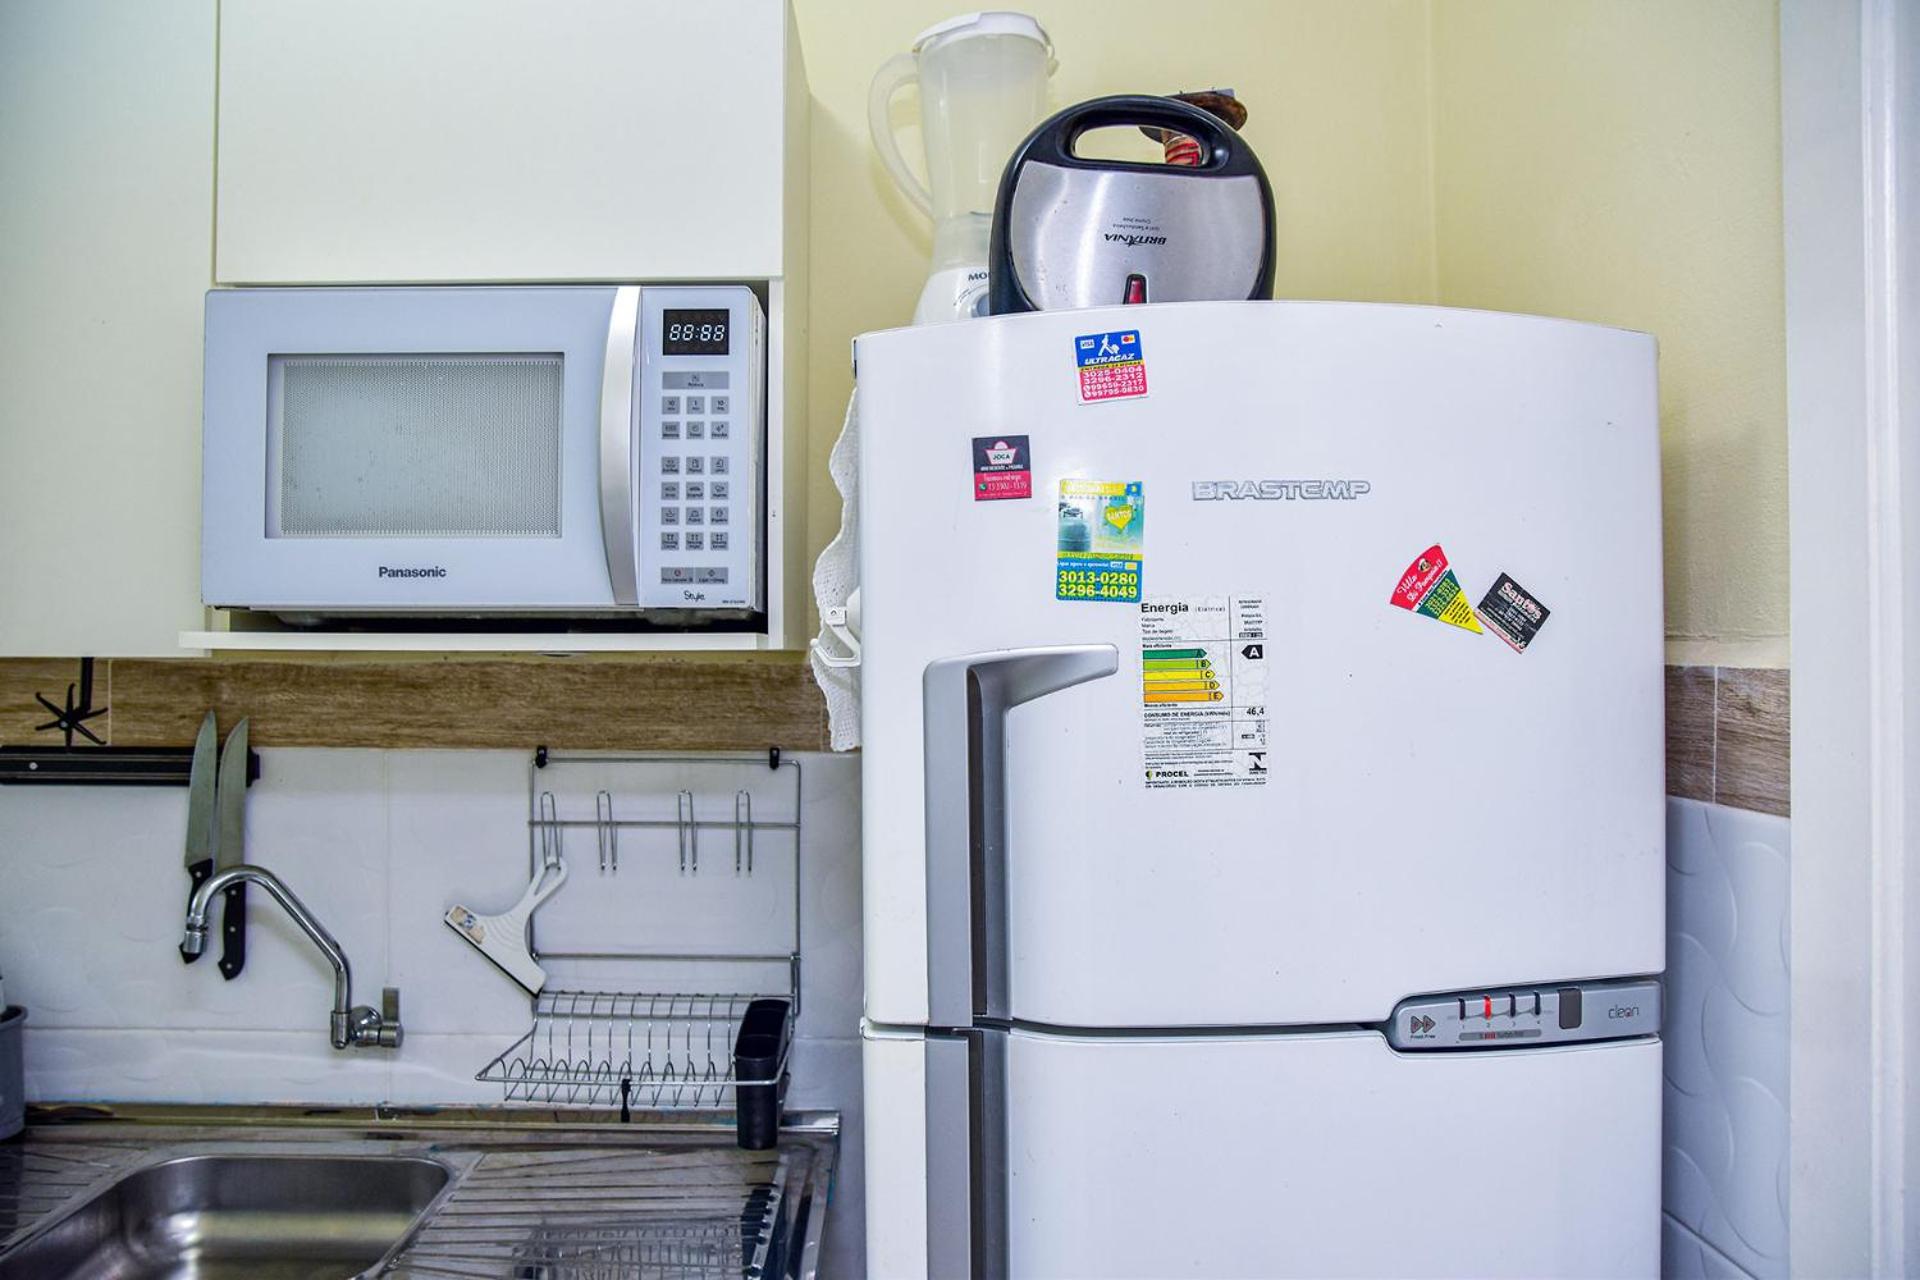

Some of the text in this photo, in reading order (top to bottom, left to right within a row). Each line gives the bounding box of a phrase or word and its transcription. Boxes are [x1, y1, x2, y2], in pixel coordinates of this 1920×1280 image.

[669, 324, 725, 341] 88:88
[1084, 353, 1135, 365] ULTRAGAZ
[1192, 480, 1371, 501] BRASTEMP
[378, 566, 447, 578] Panasonic
[1059, 570, 1137, 585] 3013-0280
[1059, 584, 1137, 598] 3296-4049
[1141, 602, 1189, 615] Energia
[1249, 646, 1260, 658] A
[1608, 1004, 1639, 1019] clean
